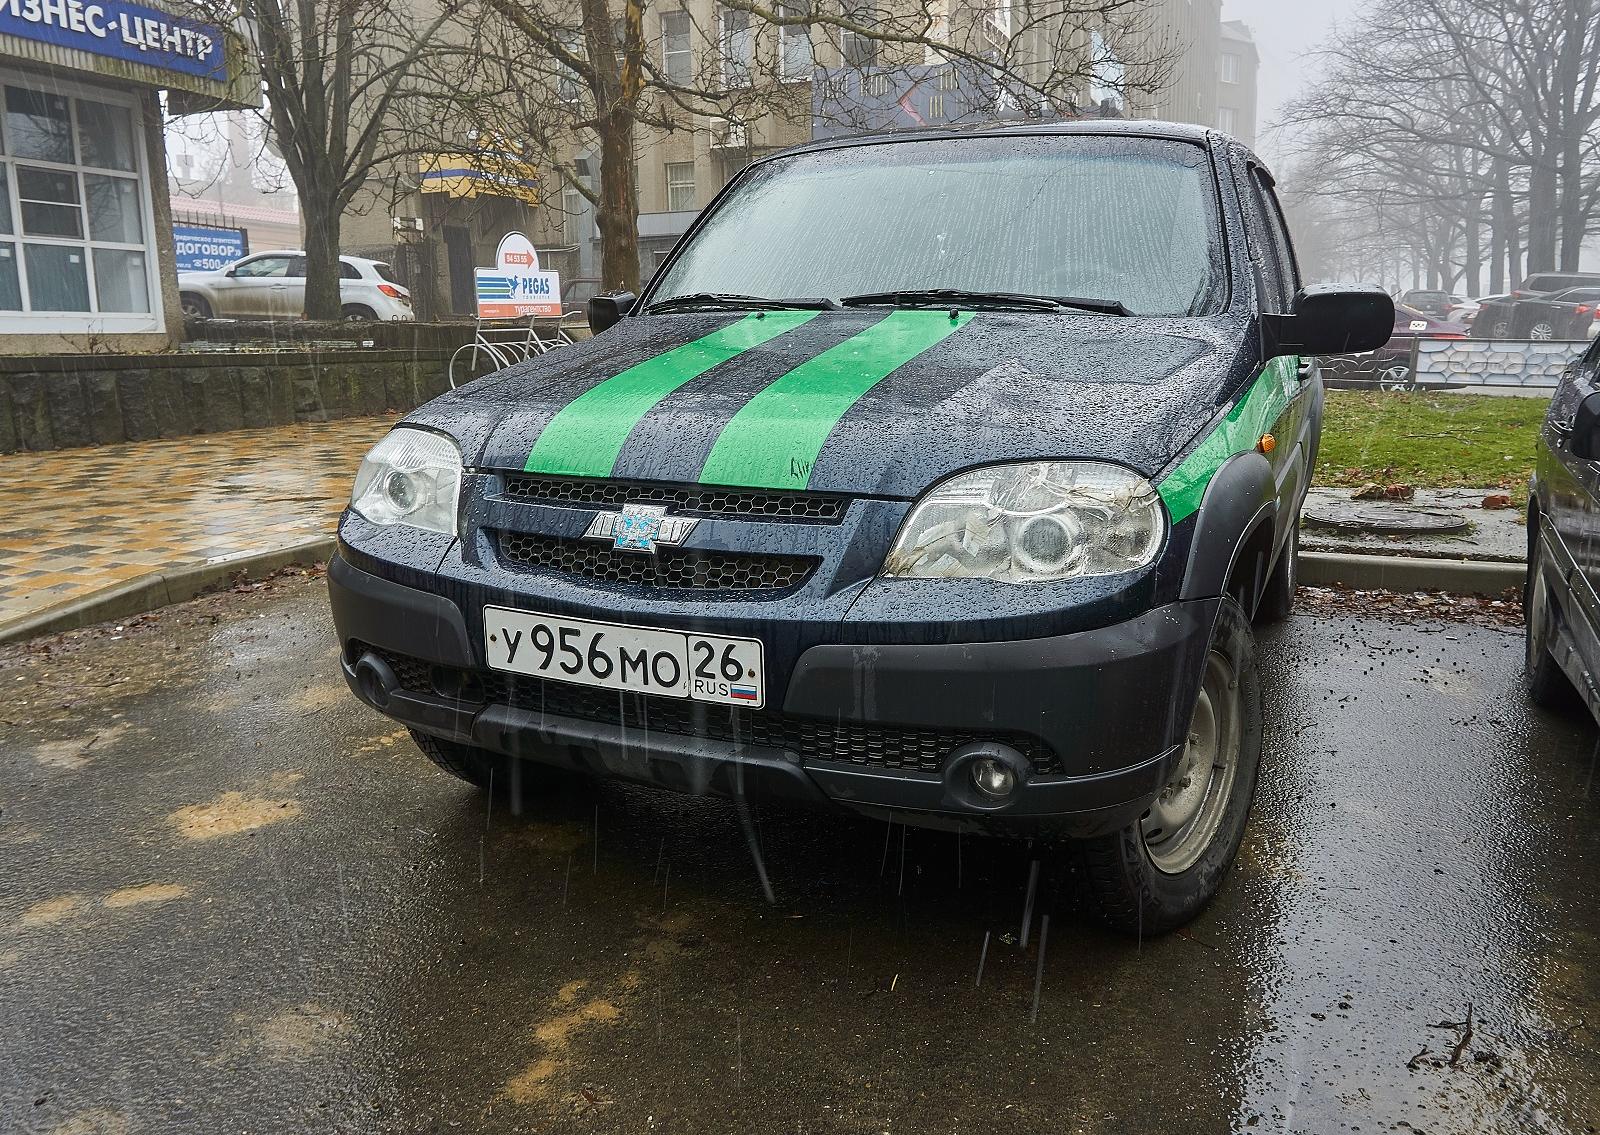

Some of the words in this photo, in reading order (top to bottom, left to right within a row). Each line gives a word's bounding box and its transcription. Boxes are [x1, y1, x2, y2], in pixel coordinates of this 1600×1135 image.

[173, 233, 211, 243] ридическое
[522, 277, 550, 295] PEGAS
[514, 305, 552, 315] турагентство
[692, 640, 744, 682] 26
[694, 679, 729, 697] RUS
